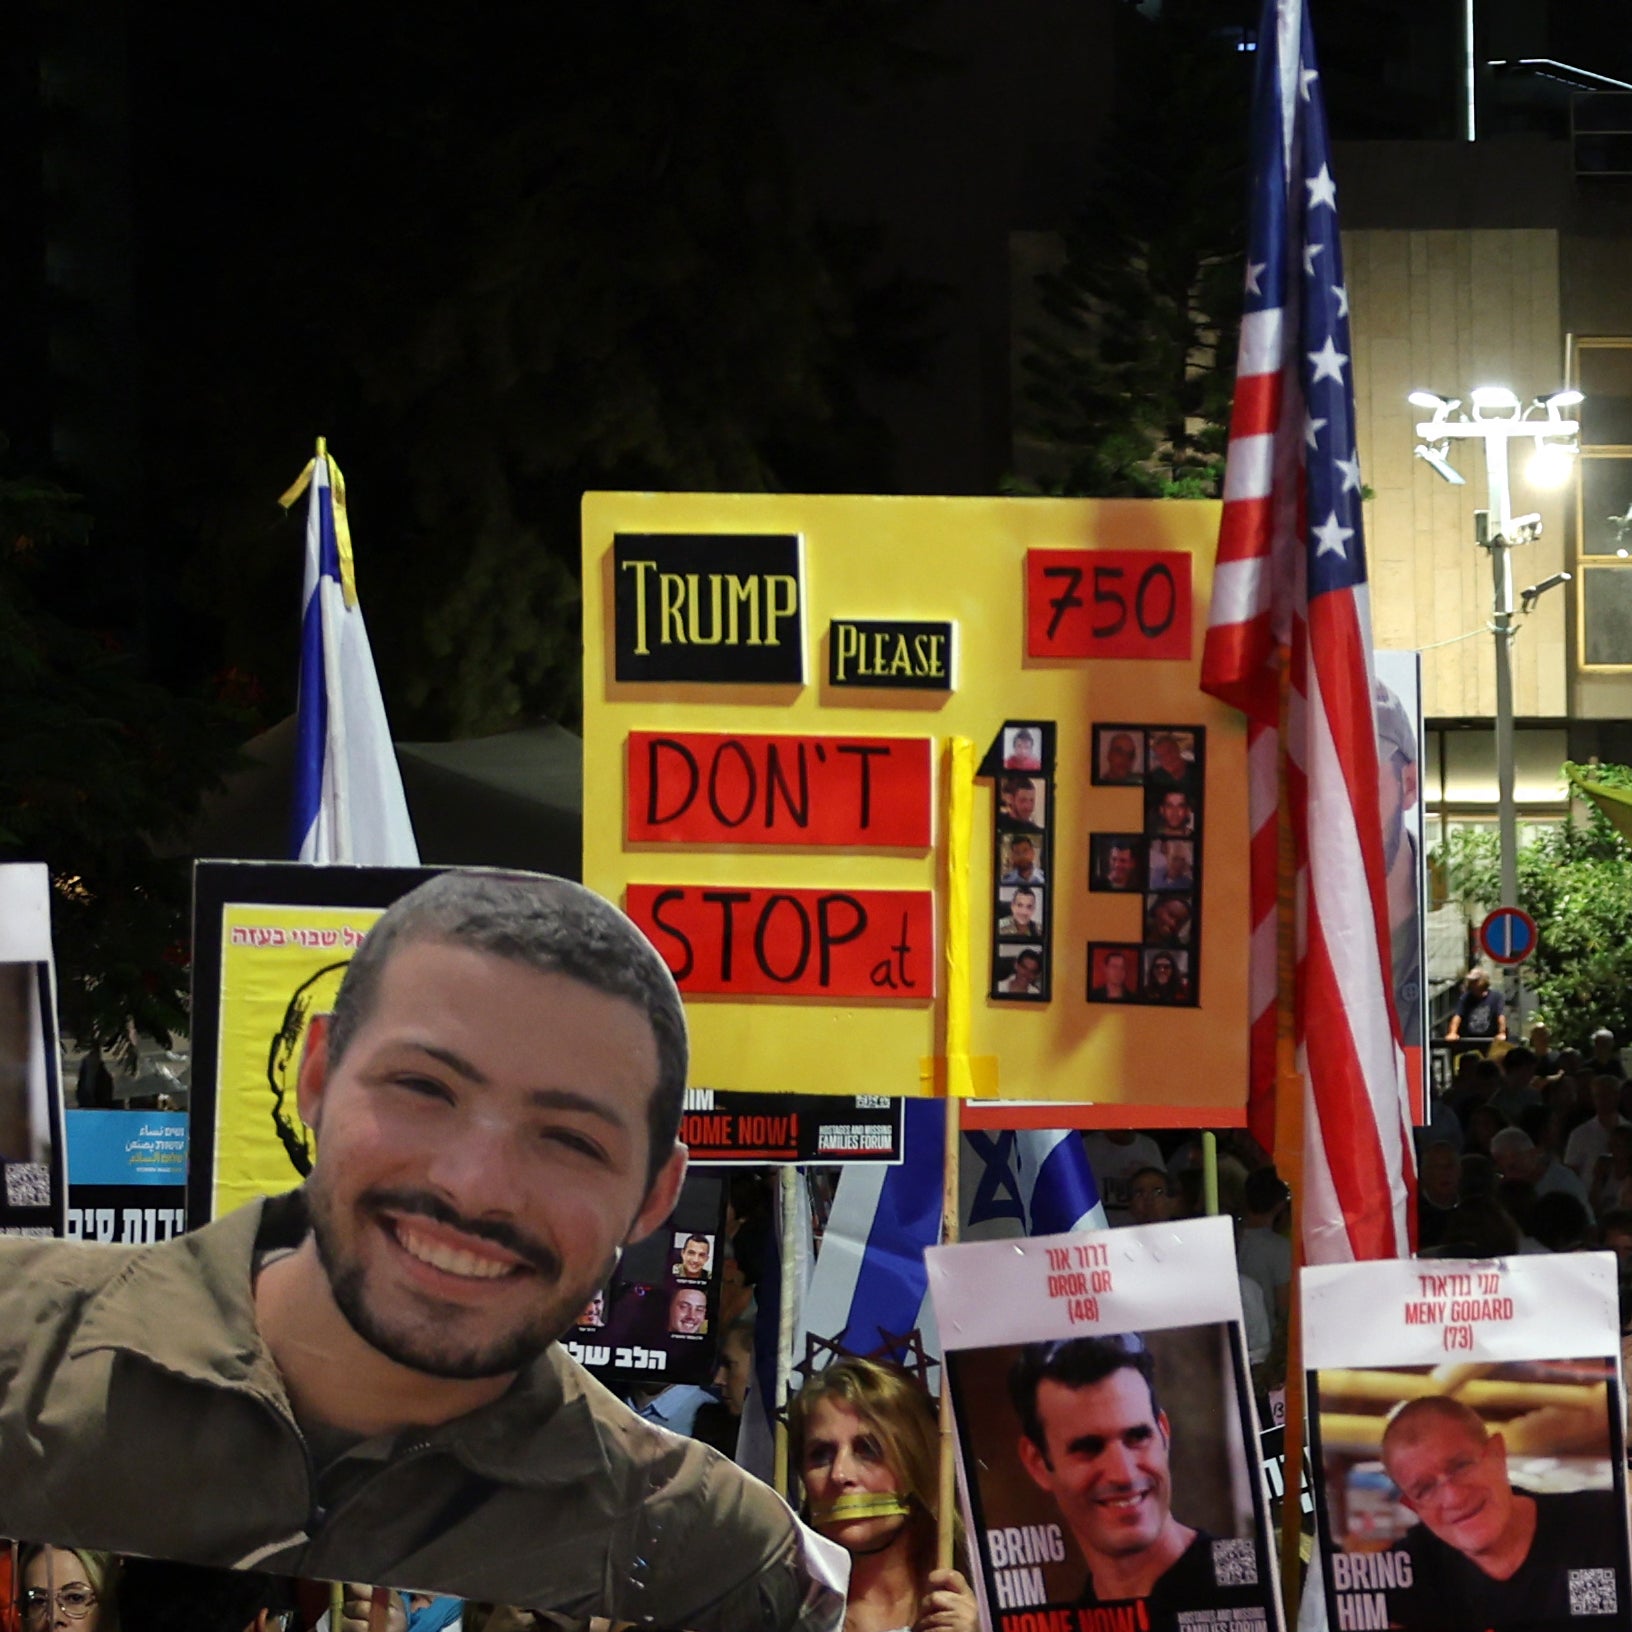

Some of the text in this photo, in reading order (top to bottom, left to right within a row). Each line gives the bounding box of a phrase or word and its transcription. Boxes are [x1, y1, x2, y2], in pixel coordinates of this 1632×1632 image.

[1043, 562, 1176, 640] 750
[621, 560, 946, 681] TRUMP PLEASE
[646, 738, 891, 830] DON'T
[232, 928, 285, 947] בעזה
[292, 928, 337, 947] שבוי
[651, 889, 917, 989] STOP at
[739, 1114, 799, 1145] NOW!
[819, 1135, 891, 1150] FAMILIES FORUM
[1046, 1244, 1108, 1270] דרור אור
[1048, 1271, 1112, 1298] DROR OR
[1478, 1274, 1500, 1293] מני
[1068, 1298, 1100, 1324] (48)
[1405, 1297, 1513, 1325] MENY GODARD
[1443, 1326, 1473, 1351] (73)
[615, 1346, 667, 1370] הלב
[987, 1523, 1065, 1568] BRING
[1332, 1550, 1413, 1591] BRING
[994, 1568, 1047, 1607] HIM
[1337, 1593, 1389, 1631] HIM
